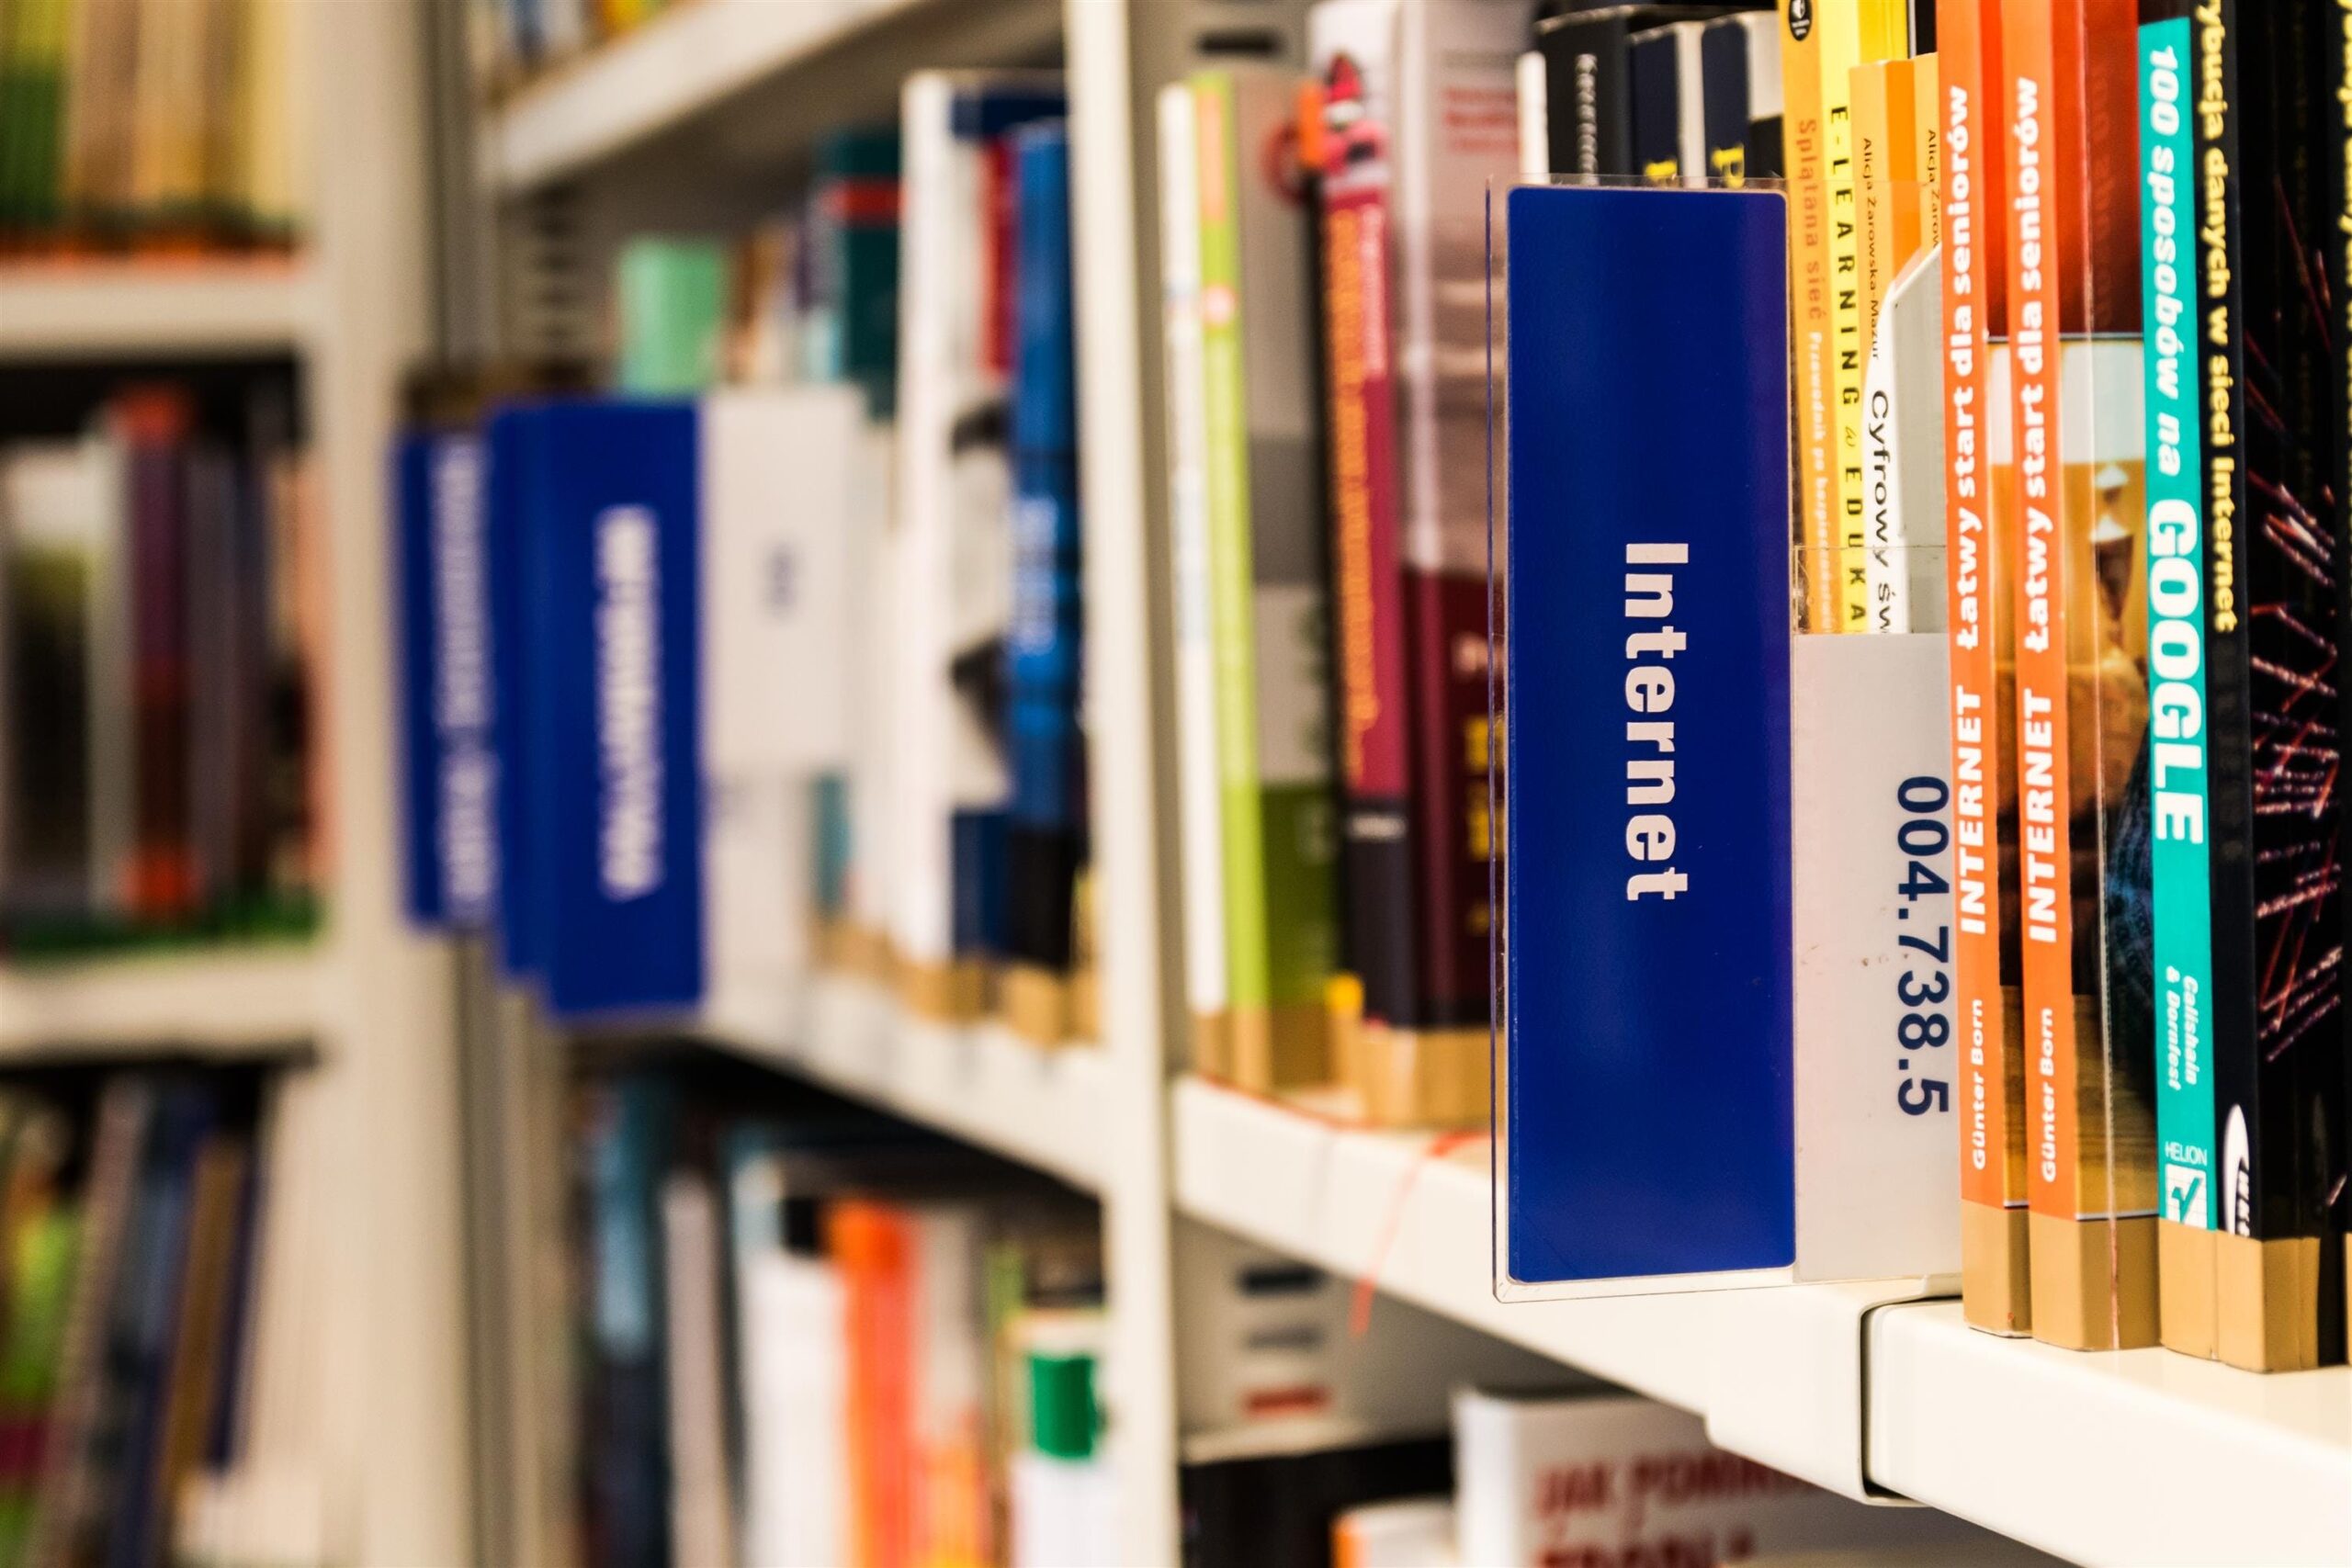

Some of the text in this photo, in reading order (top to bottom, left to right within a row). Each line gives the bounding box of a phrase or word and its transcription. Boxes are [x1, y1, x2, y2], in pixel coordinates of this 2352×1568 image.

[1863, 138, 1874, 190] Alicja
[1928, 130, 1937, 183] Alicja
[2202, 148, 2230, 297] danych
[1832, 107, 1859, 404] E-LEARNING
[2208, 304, 2230, 348] w
[1870, 391, 1889, 566] Cyfrowy
[2148, 47, 2204, 844] 100 sposobów na GOOGLE
[2210, 354, 2235, 446] sieci
[1946, 85, 1985, 933] INTERNET Łatwy start dla seniorów
[2014, 77, 2056, 942] INTERNET Łatwy start dla seniorów
[2212, 457, 2237, 631] Internet
[1625, 544, 1688, 900] Internet
[1898, 776, 1950, 1115] 004.738.5
[1971, 999, 1984, 1169] Günter Born
[2041, 1009, 2055, 1181] Günter Born
[2165, 1141, 2207, 1166] HELION
